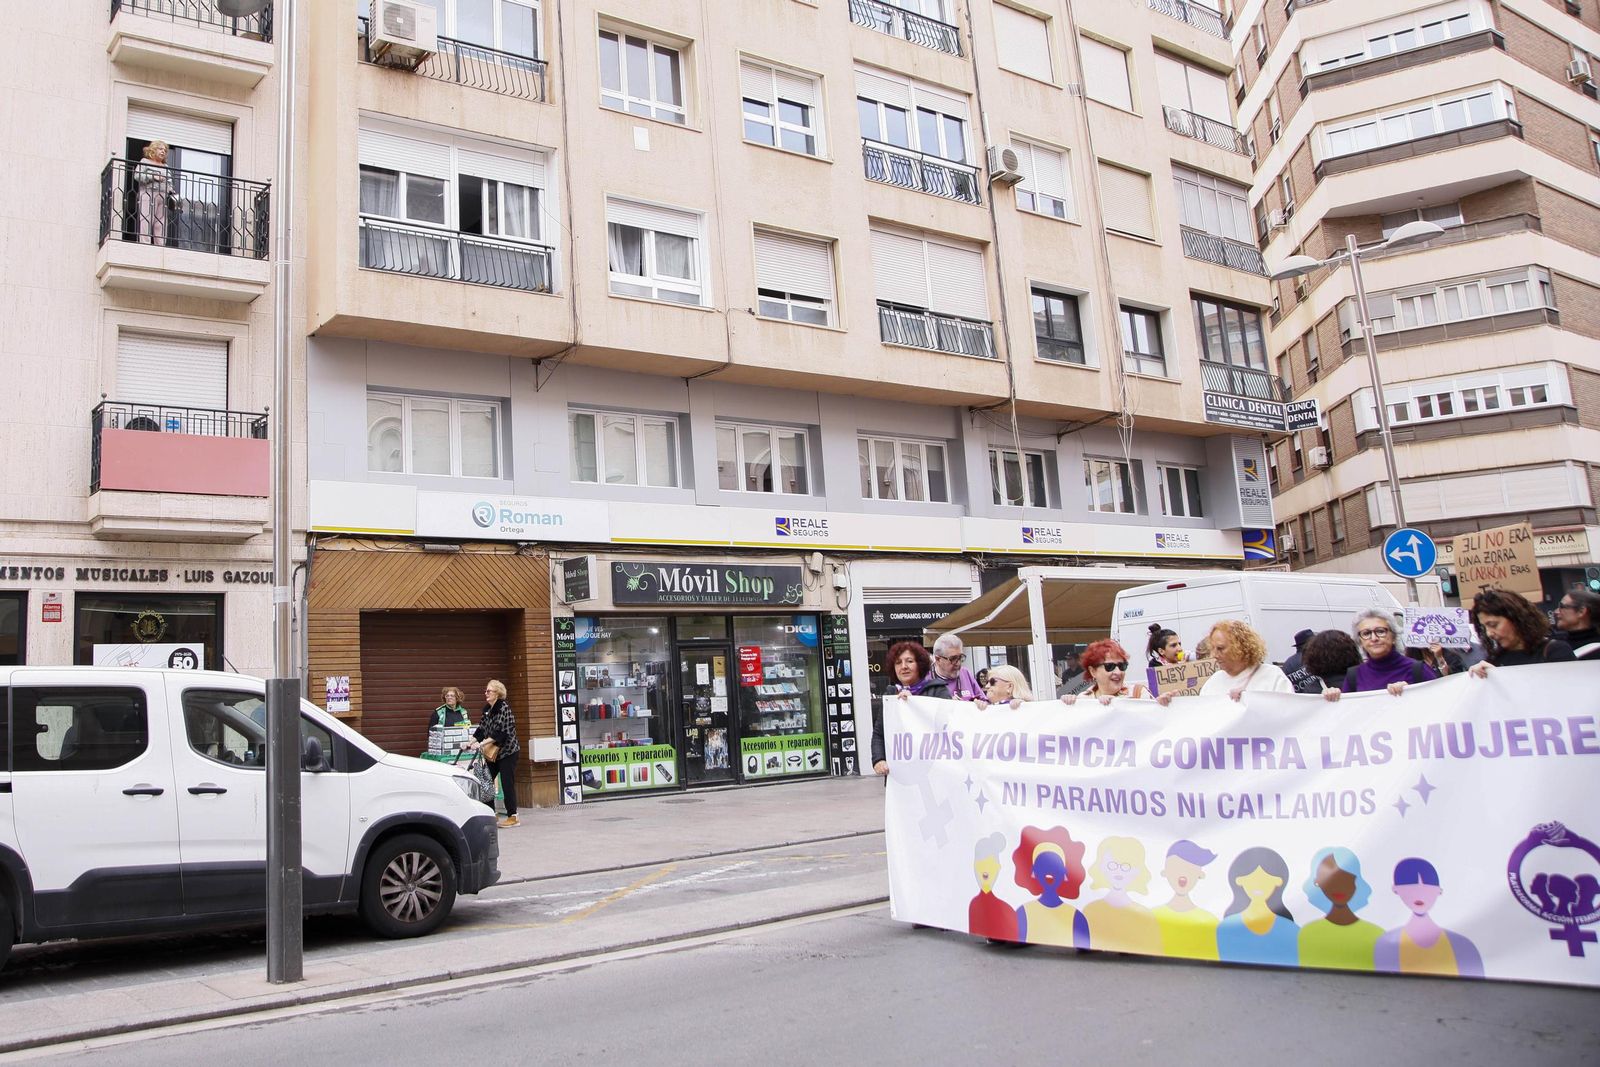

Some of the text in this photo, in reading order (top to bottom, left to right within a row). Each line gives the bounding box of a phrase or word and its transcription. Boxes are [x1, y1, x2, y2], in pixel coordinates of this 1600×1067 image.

[1206, 394, 1283, 416] CLINICA DENTAL
[1286, 400, 1316, 413] CLINICA
[1288, 410, 1317, 423] DENTAL
[1240, 488, 1267, 499] REALE
[1241, 498, 1269, 506] SEGUROS
[499, 508, 563, 526] Roman
[792, 518, 829, 529] REALE
[500, 526, 525, 534] Ortega
[792, 529, 829, 537] SEGUROS
[1034, 527, 1062, 537] REALE
[1165, 533, 1190, 542] REALE
[1485, 531, 1504, 550] NO
[1509, 527, 1531, 544] ERA
[1539, 535, 1576, 545] ASMA
[1458, 548, 1517, 568] UNA ZORRA
[76, 567, 169, 583] MUSICALES
[184, 570, 215, 583] LUIS
[1459, 571, 1471, 583] EL
[1510, 564, 1531, 575] ERAS
[657, 567, 774, 601] Móvil Shop
[784, 624, 813, 634] DIGI
[556, 632, 575, 641] Móvil
[557, 641, 574, 650] Shop
[172, 656, 195, 670] 50
[1156, 665, 1187, 686] LEY
[743, 735, 822, 752] Accesorios y reparación
[892, 732, 913, 761] NO
[919, 724, 965, 761] MÁS
[971, 731, 1137, 768] VIOLENCIA
[1150, 736, 1307, 770] CONTRA
[1319, 731, 1394, 769] LAS
[580, 751, 620, 765] Accesorios
[623, 751, 629, 762] y
[632, 746, 673, 761] reparación
[1001, 781, 1376, 820] NI PARAMOS NI CALLAMOS
